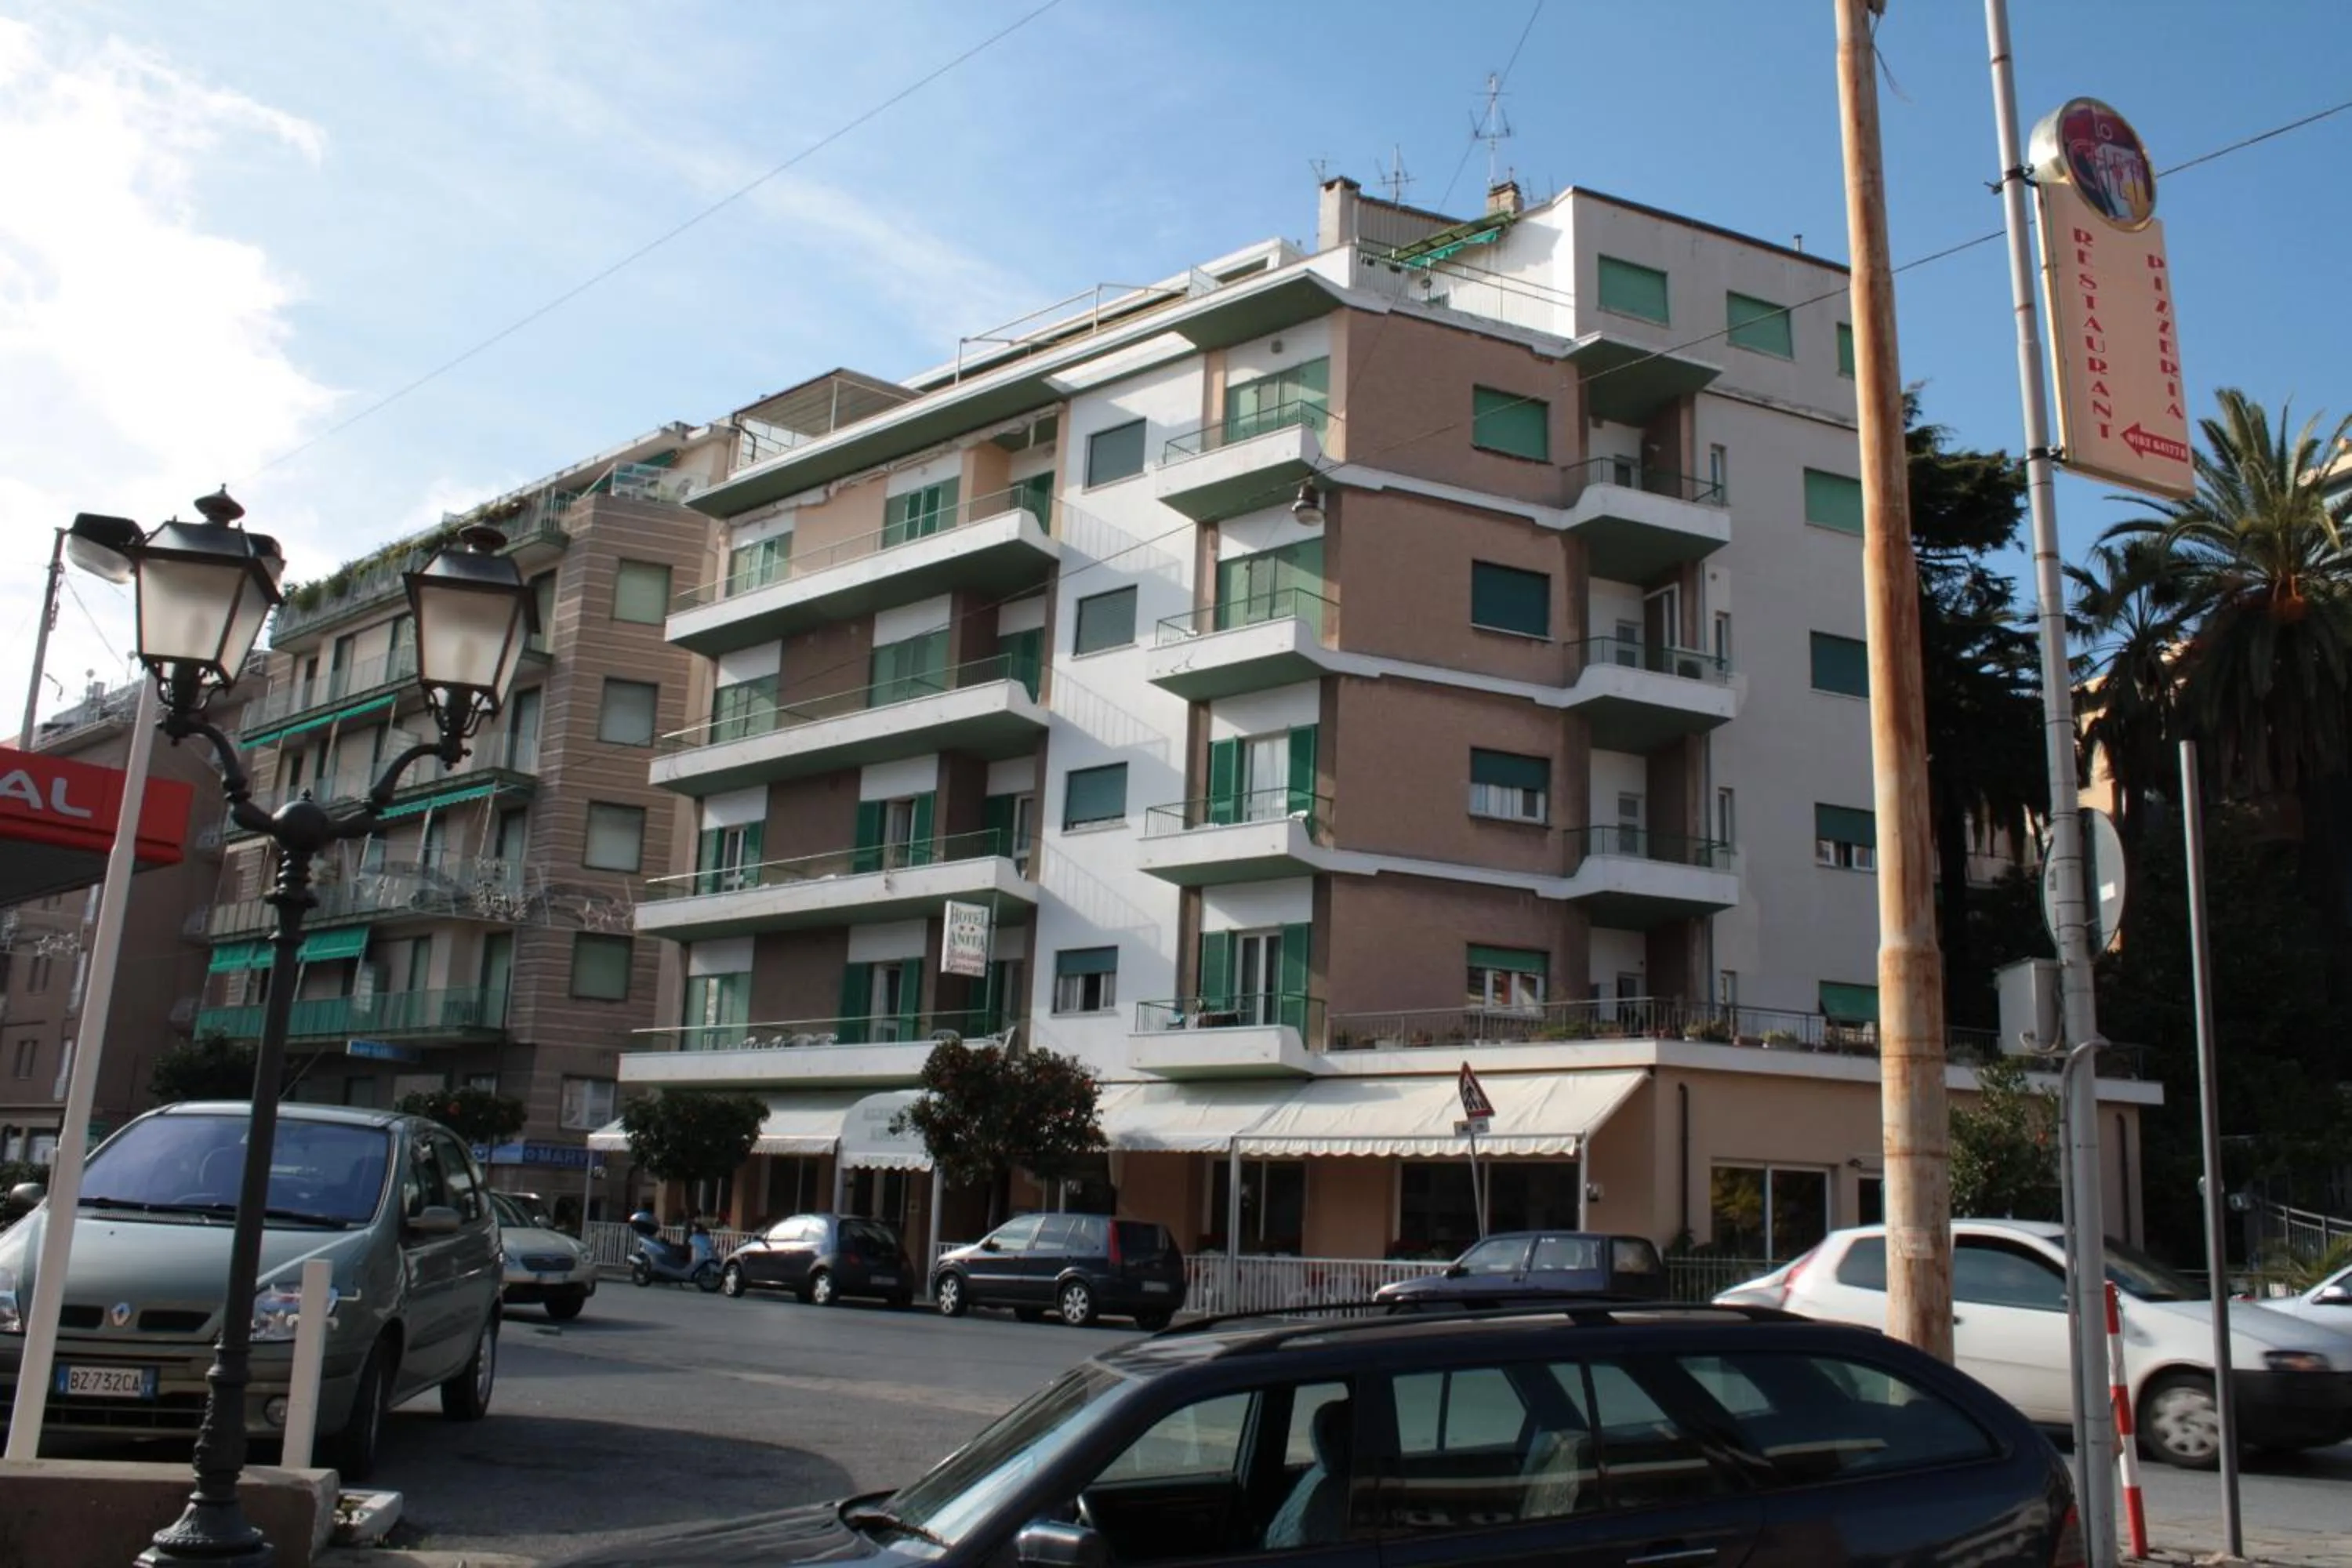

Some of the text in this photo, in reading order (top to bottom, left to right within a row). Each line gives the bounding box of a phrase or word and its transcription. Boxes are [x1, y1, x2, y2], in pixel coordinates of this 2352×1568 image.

[2073, 227, 2112, 439] RESTAURANT
[2147, 254, 2184, 420] PIZZERIA
[0, 769, 92, 818] AL
[950, 904, 987, 927] HOTEL
[947, 931, 985, 953] ANITA
